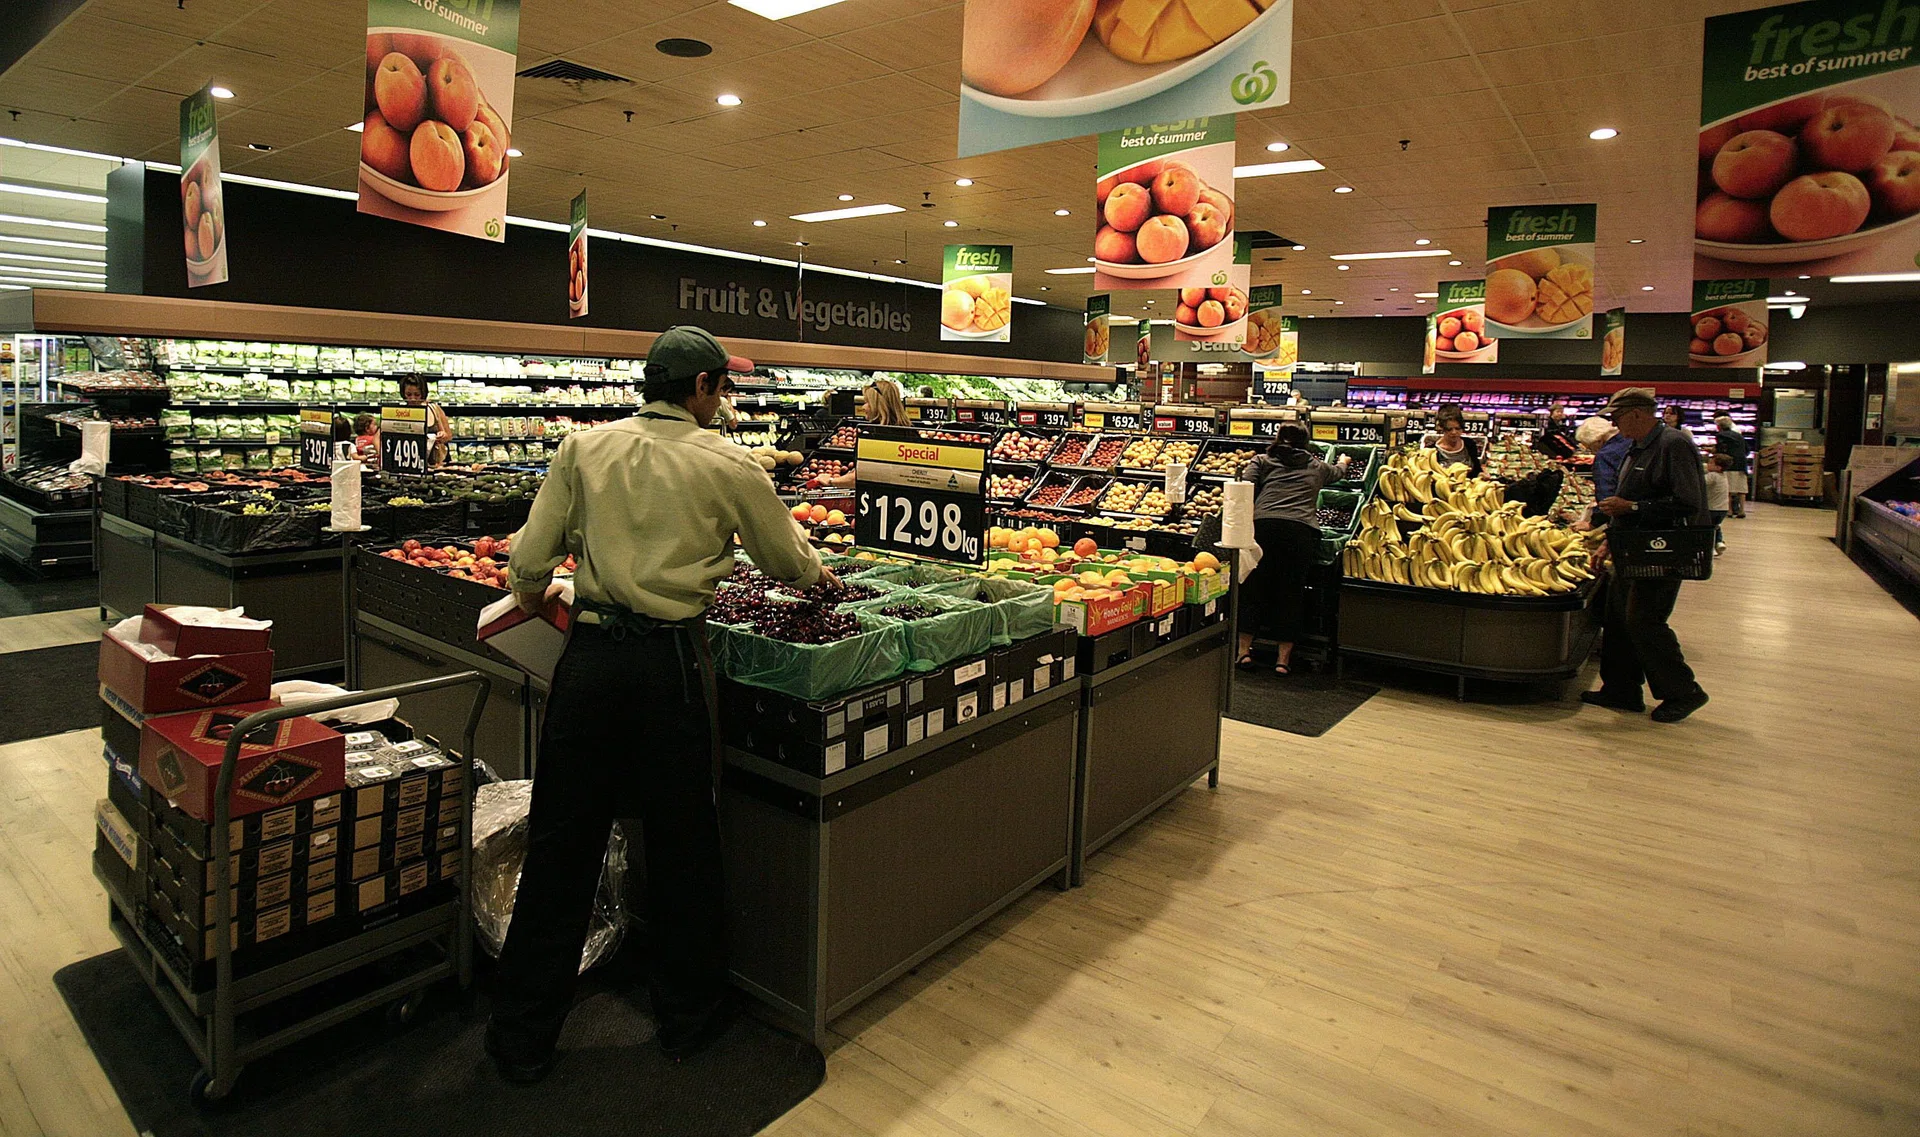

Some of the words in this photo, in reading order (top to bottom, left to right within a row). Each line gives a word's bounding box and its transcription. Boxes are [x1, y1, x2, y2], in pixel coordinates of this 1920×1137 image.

[438, 5, 489, 36] summer
[1750, 0, 1920, 64] fresh
[1744, 64, 1788, 82] best
[1791, 57, 1816, 76] of
[1816, 47, 1912, 72] summer
[1121, 136, 1145, 148] best
[1146, 133, 1160, 146] of
[1158, 131, 1208, 145] summer
[1508, 209, 1577, 233] fresh
[1506, 234, 1525, 242] best
[1525, 232, 1537, 241] of
[1536, 233, 1574, 241] summer
[956, 247, 1001, 265] fresh
[1707, 279, 1756, 294] fresh
[679, 277, 750, 316] Fruit
[757, 287, 778, 319] &
[784, 290, 911, 332] Vegetables
[395, 408, 411, 418] Special
[898, 444, 939, 461] Special
[240, 753, 277, 786] AUSSIE
